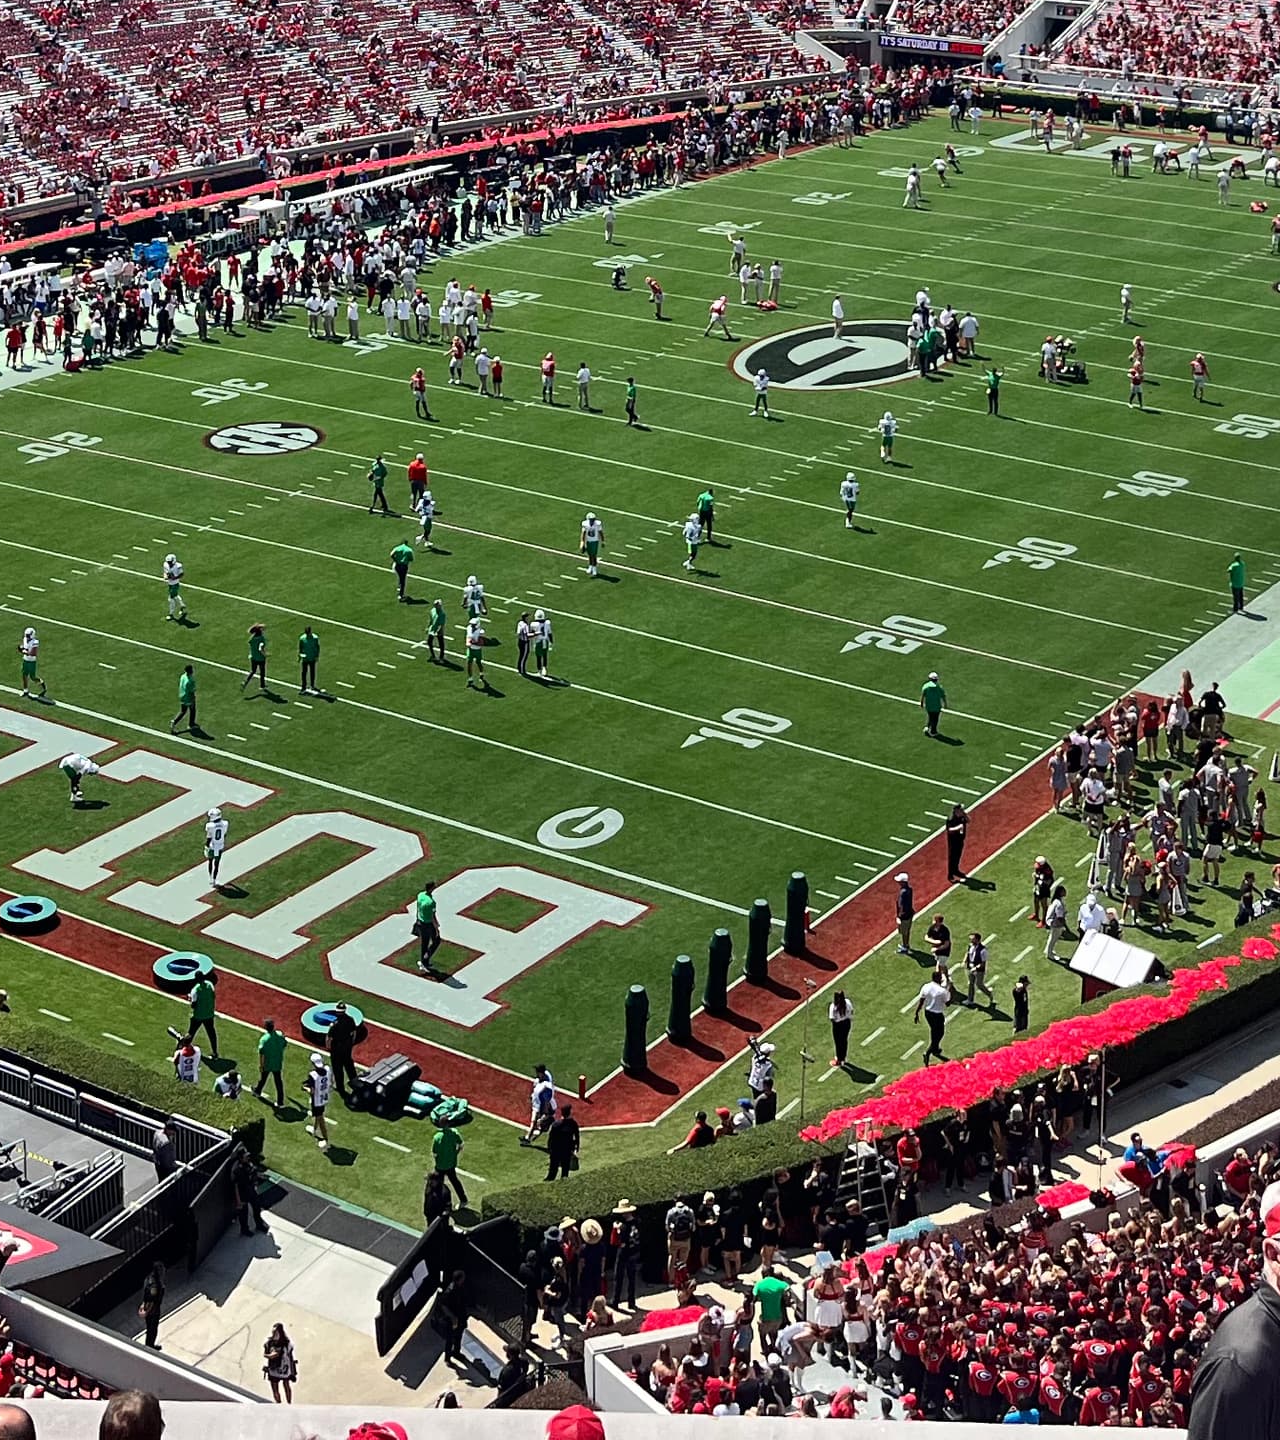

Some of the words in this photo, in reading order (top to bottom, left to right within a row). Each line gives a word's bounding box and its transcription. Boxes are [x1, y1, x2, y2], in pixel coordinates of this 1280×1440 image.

[880, 35, 896, 46] IT'S
[896, 37, 938, 50] SATURDAY
[191, 377, 270, 402] 30
[17, 431, 103, 458] 20
[1117, 470, 1190, 498] 40
[994, 536, 1079, 570] 30
[854, 614, 948, 655] 20
[699, 707, 793, 749] 10
[214, 828, 222, 841] 0
